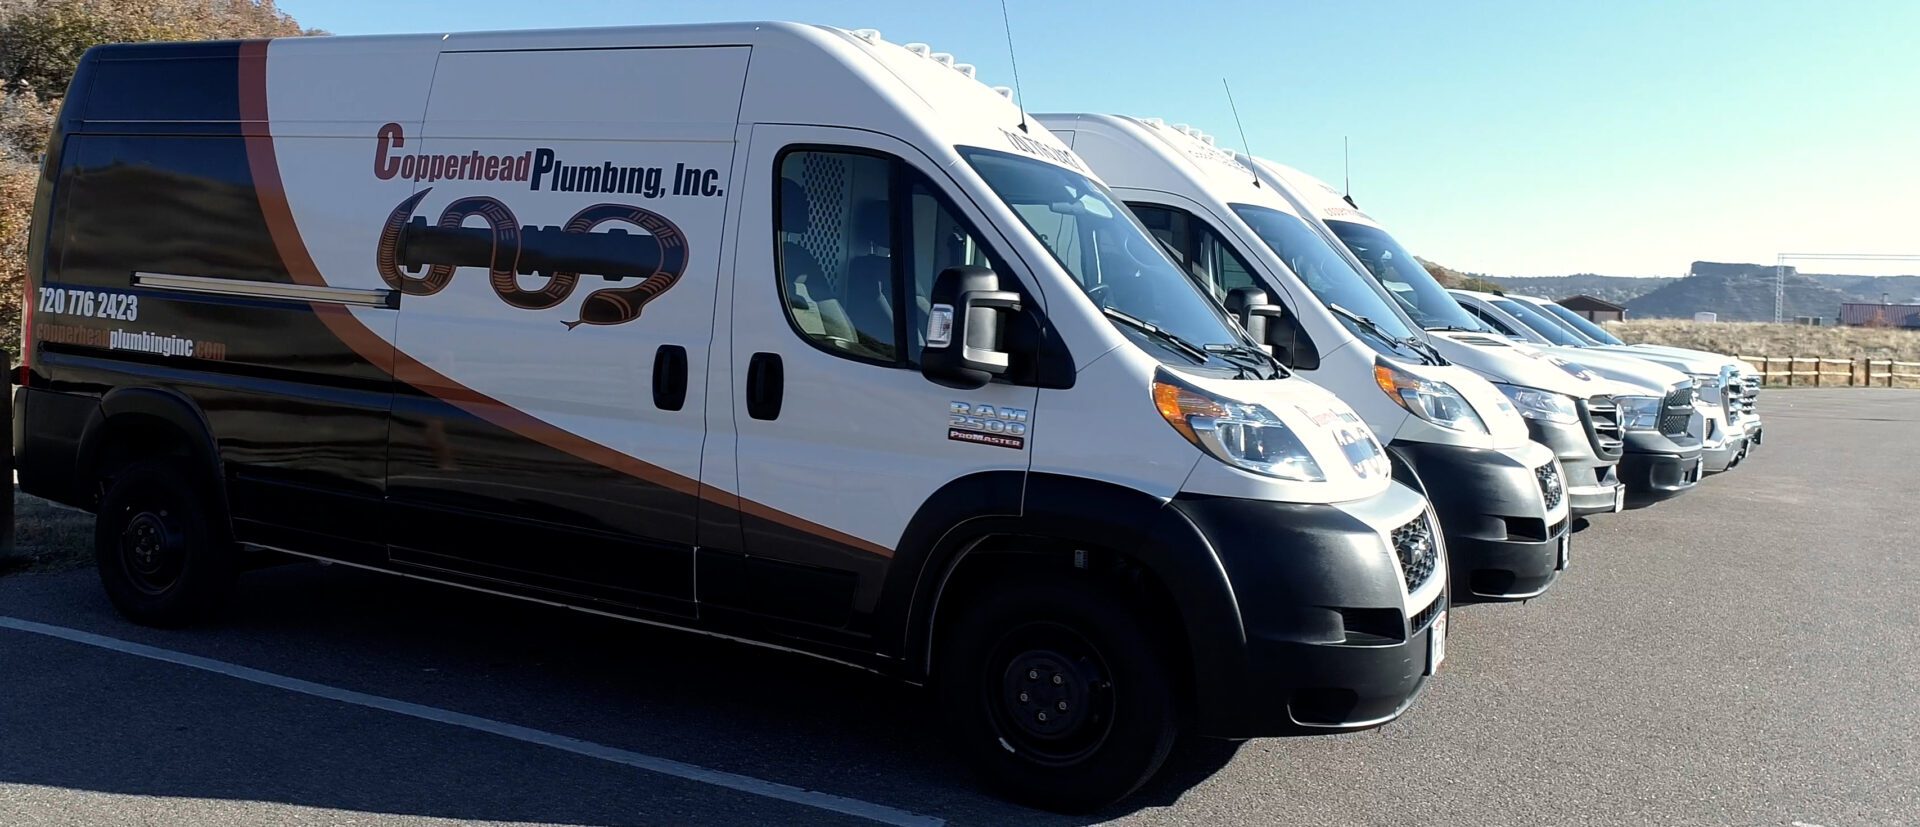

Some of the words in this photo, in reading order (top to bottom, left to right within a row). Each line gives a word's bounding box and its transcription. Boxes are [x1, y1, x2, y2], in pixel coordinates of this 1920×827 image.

[672, 162, 724, 197] Inc.
[38, 287, 66, 314] 720
[68, 289, 95, 317] 776
[97, 292, 138, 322] 2423
[948, 414, 1027, 437] 2500
[949, 400, 1029, 422] RAM
